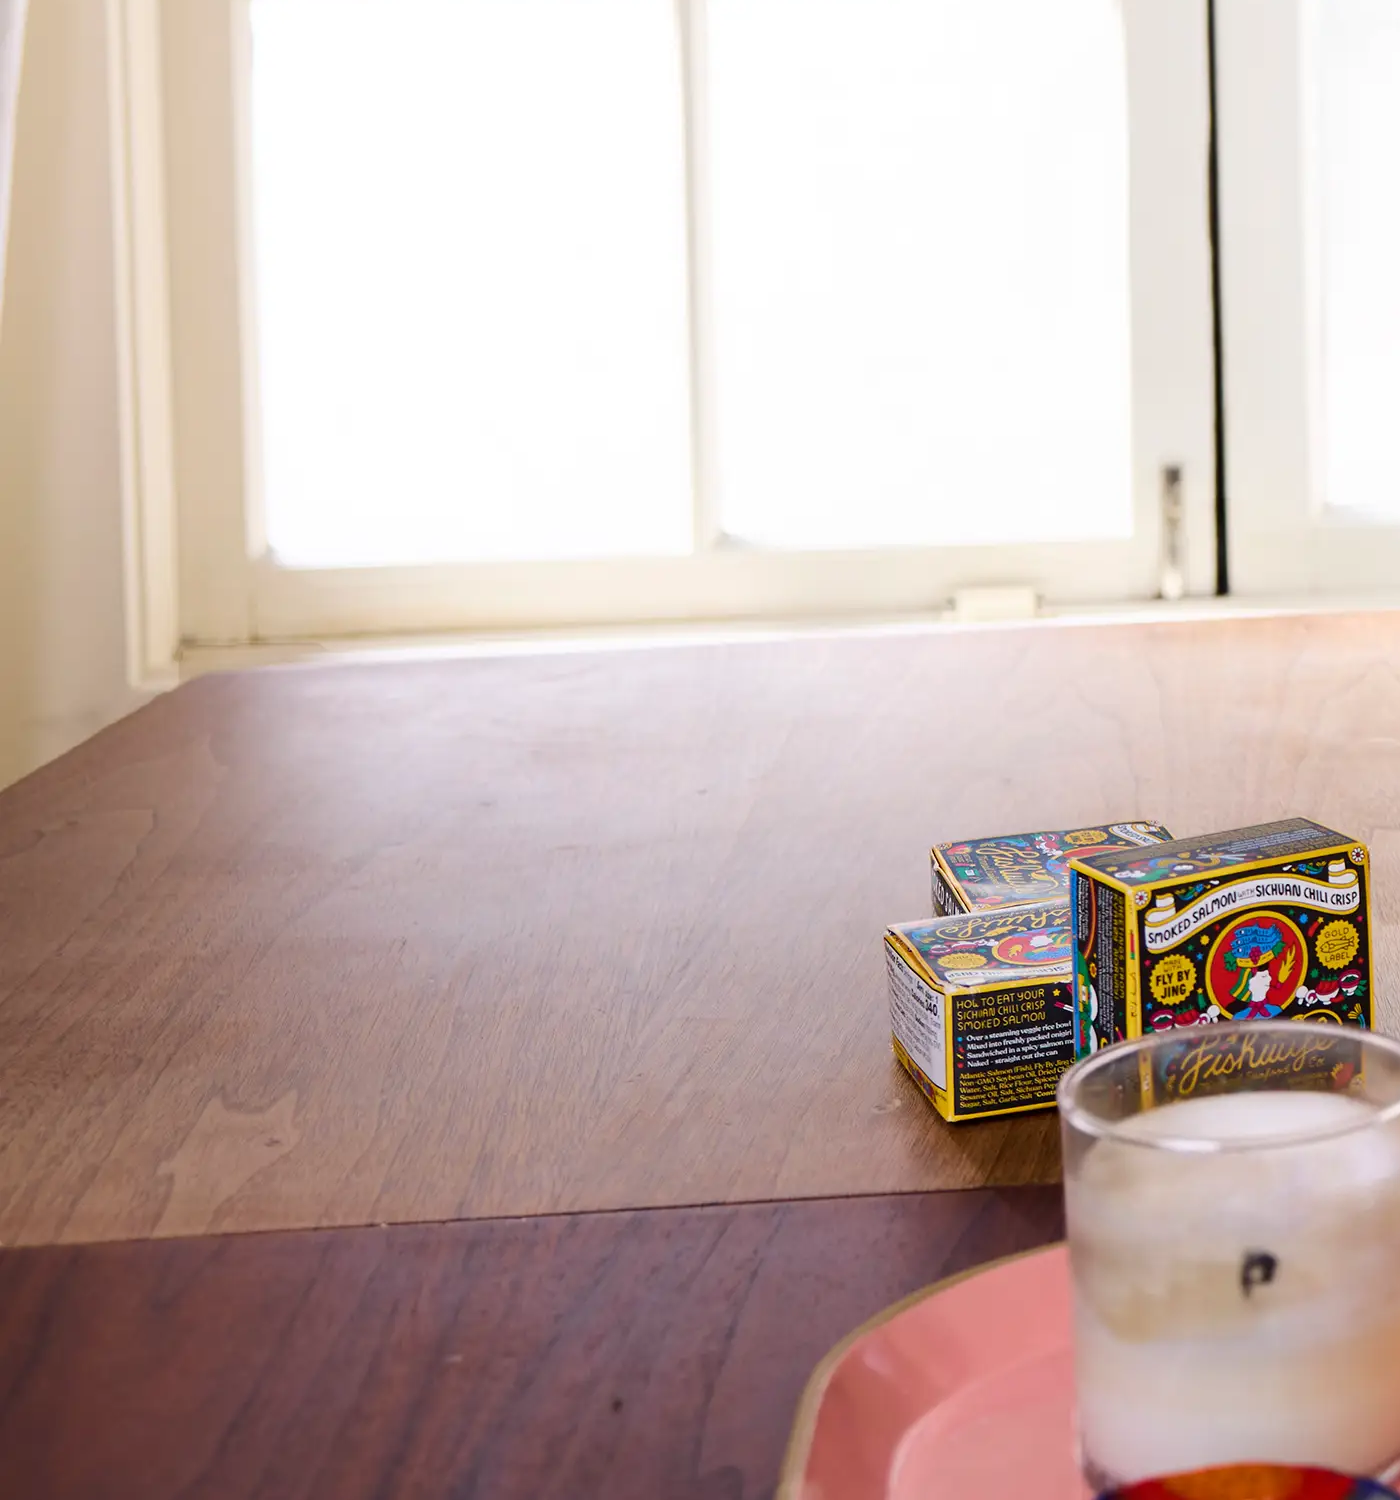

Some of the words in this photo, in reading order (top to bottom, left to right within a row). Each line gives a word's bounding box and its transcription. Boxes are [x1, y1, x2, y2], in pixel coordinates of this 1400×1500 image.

[1148, 918, 1191, 944] SMOKED
[1192, 891, 1237, 923] SALMON
[1255, 883, 1302, 897] SICHUAN
[1304, 887, 1328, 903] CHILI
[1330, 891, 1357, 905] CRISP
[1325, 927, 1349, 938] GOLD
[1325, 952, 1350, 963] LABEL
[1156, 973, 1173, 987] FLY
[1177, 969, 1191, 982] BY
[981, 997, 995, 1006] TO
[997, 993, 1015, 1004] EAT
[1017, 988, 1045, 1001] YOUR
[1161, 984, 1186, 999] JING
[957, 1007, 996, 1021] SICHUAN
[998, 1004, 1019, 1015] CHILI
[1021, 1000, 1046, 1011] CRISP
[957, 1017, 1000, 1031] SMOKED
[1003, 1011, 1046, 1026] SALMON
[989, 1029, 1020, 1040] steaming
[1020, 1025, 1041, 1035] veggie
[1042, 1023, 1055, 1031] rice
[1056, 1020, 1072, 1029] bowl
[967, 1042, 988, 1050] Mixed
[1003, 1036, 1025, 1047] freshly
[1027, 1032, 1050, 1044] packed
[1051, 1029, 1072, 1040] onigiri
[967, 1048, 1008, 1059] Sandwiched
[1021, 1042, 1038, 1053] spicy
[1039, 1039, 1064, 1049] salmon
[967, 1059, 989, 1068] Naked
[995, 1053, 1020, 1065] straight
[987, 1068, 1013, 1076] Salmon
